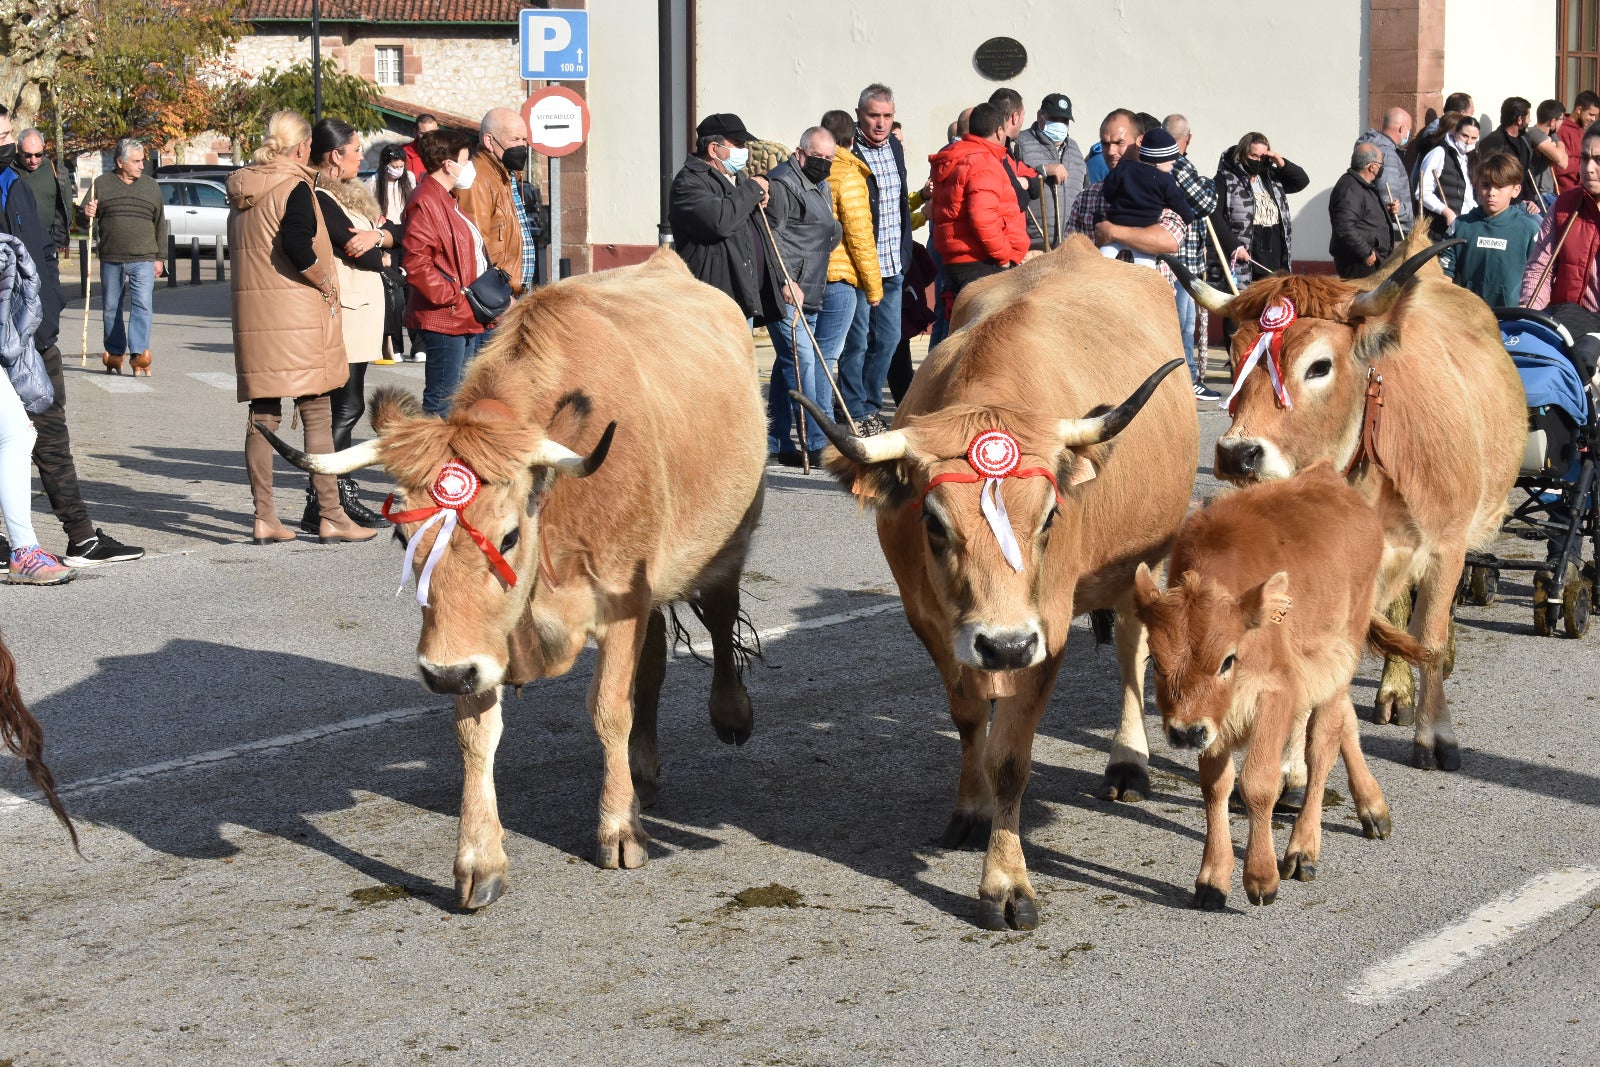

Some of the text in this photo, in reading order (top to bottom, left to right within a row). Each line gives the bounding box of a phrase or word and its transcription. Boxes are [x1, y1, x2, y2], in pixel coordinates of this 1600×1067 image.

[528, 15, 572, 72] P
[560, 63, 584, 72] 100 m
